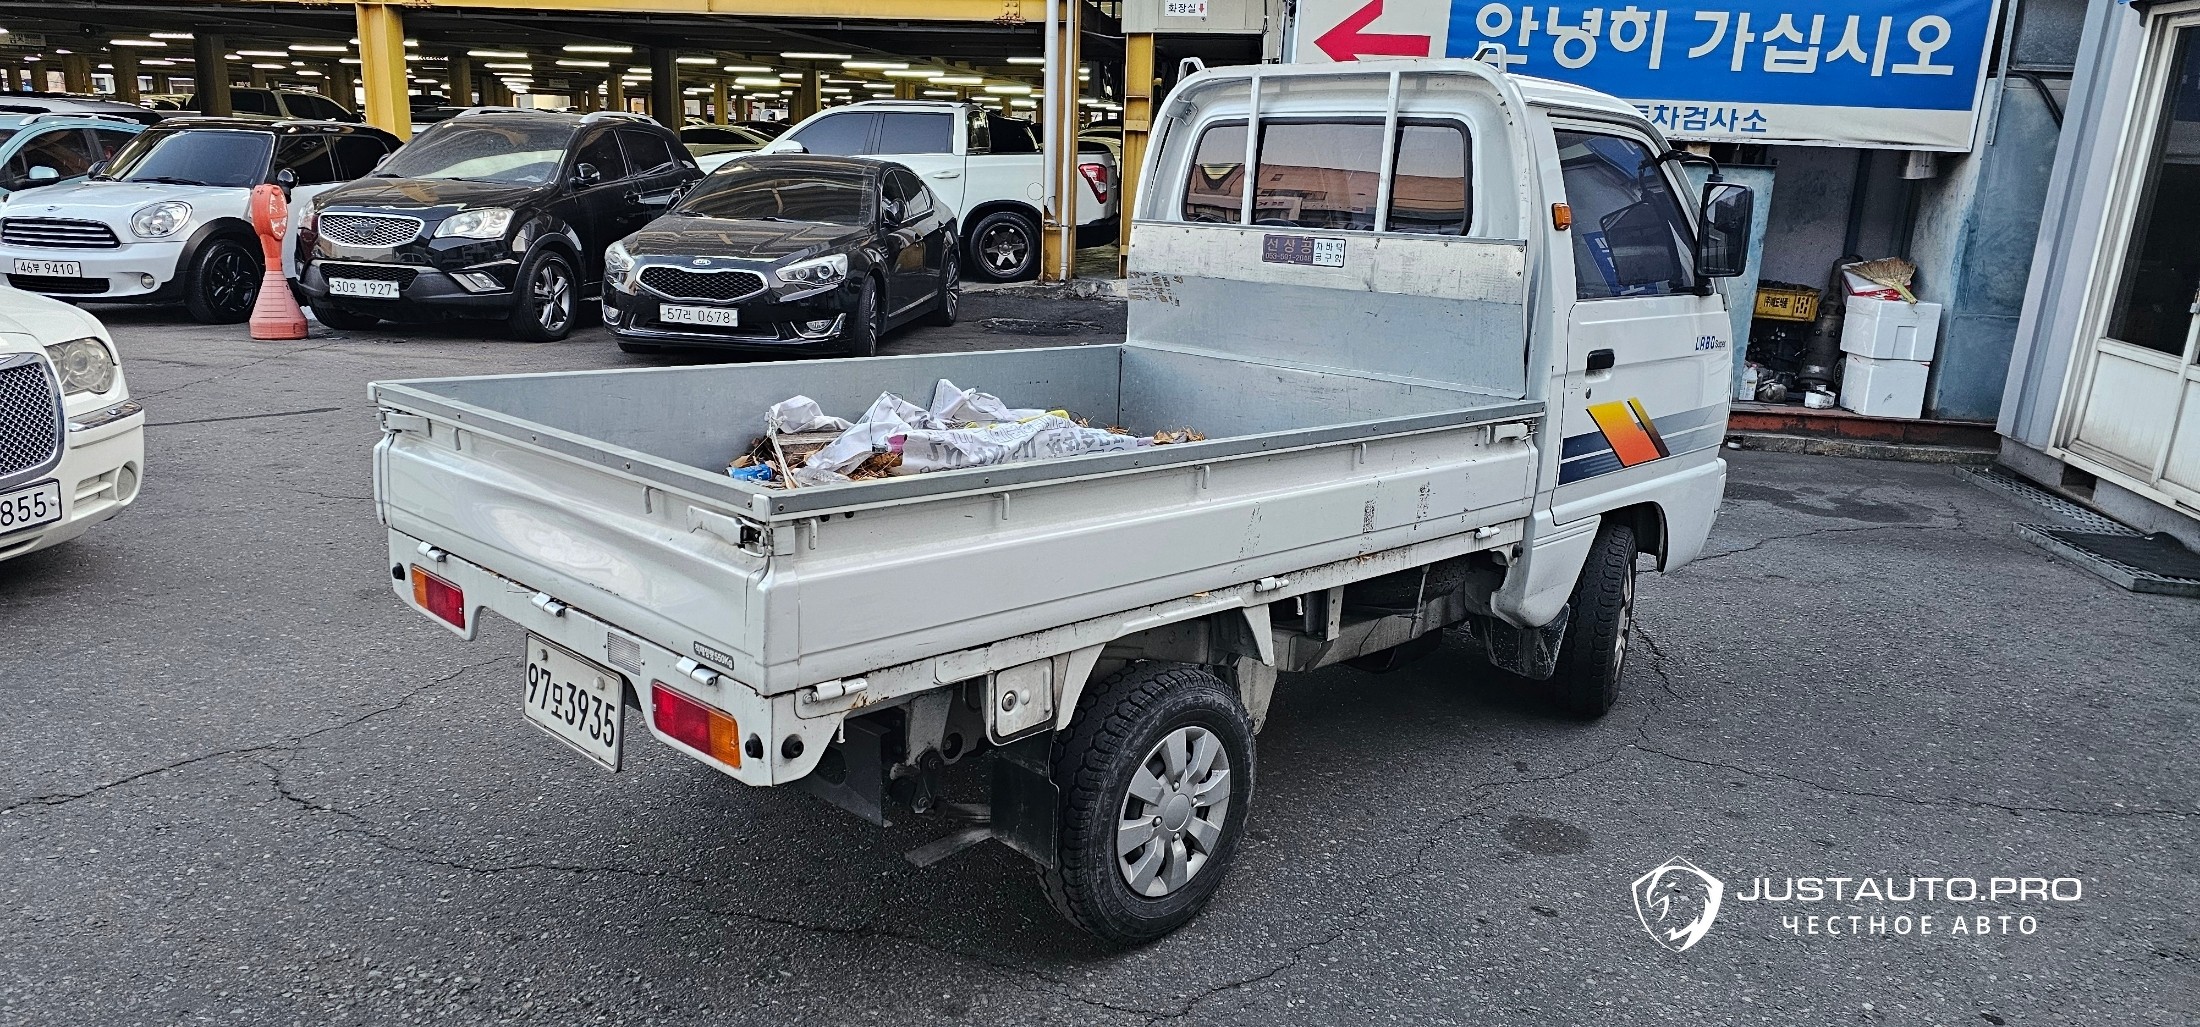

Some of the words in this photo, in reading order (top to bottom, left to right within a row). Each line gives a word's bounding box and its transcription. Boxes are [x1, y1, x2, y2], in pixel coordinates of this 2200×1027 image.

[1169, 3, 1195, 13] 화장실
[1475, 2, 1669, 70] 안녕히
[1688, 11, 1955, 77] 가십시오
[21, 262, 39, 273] 46부
[45, 263, 73, 274] 9410
[335, 281, 356, 292] 30오
[364, 282, 392, 295] 1927
[698, 310, 730, 323] 0678
[1695, 335, 1715, 350] LABO
[0, 492, 46, 526] 855
[528, 662, 615, 748] 97모3935
